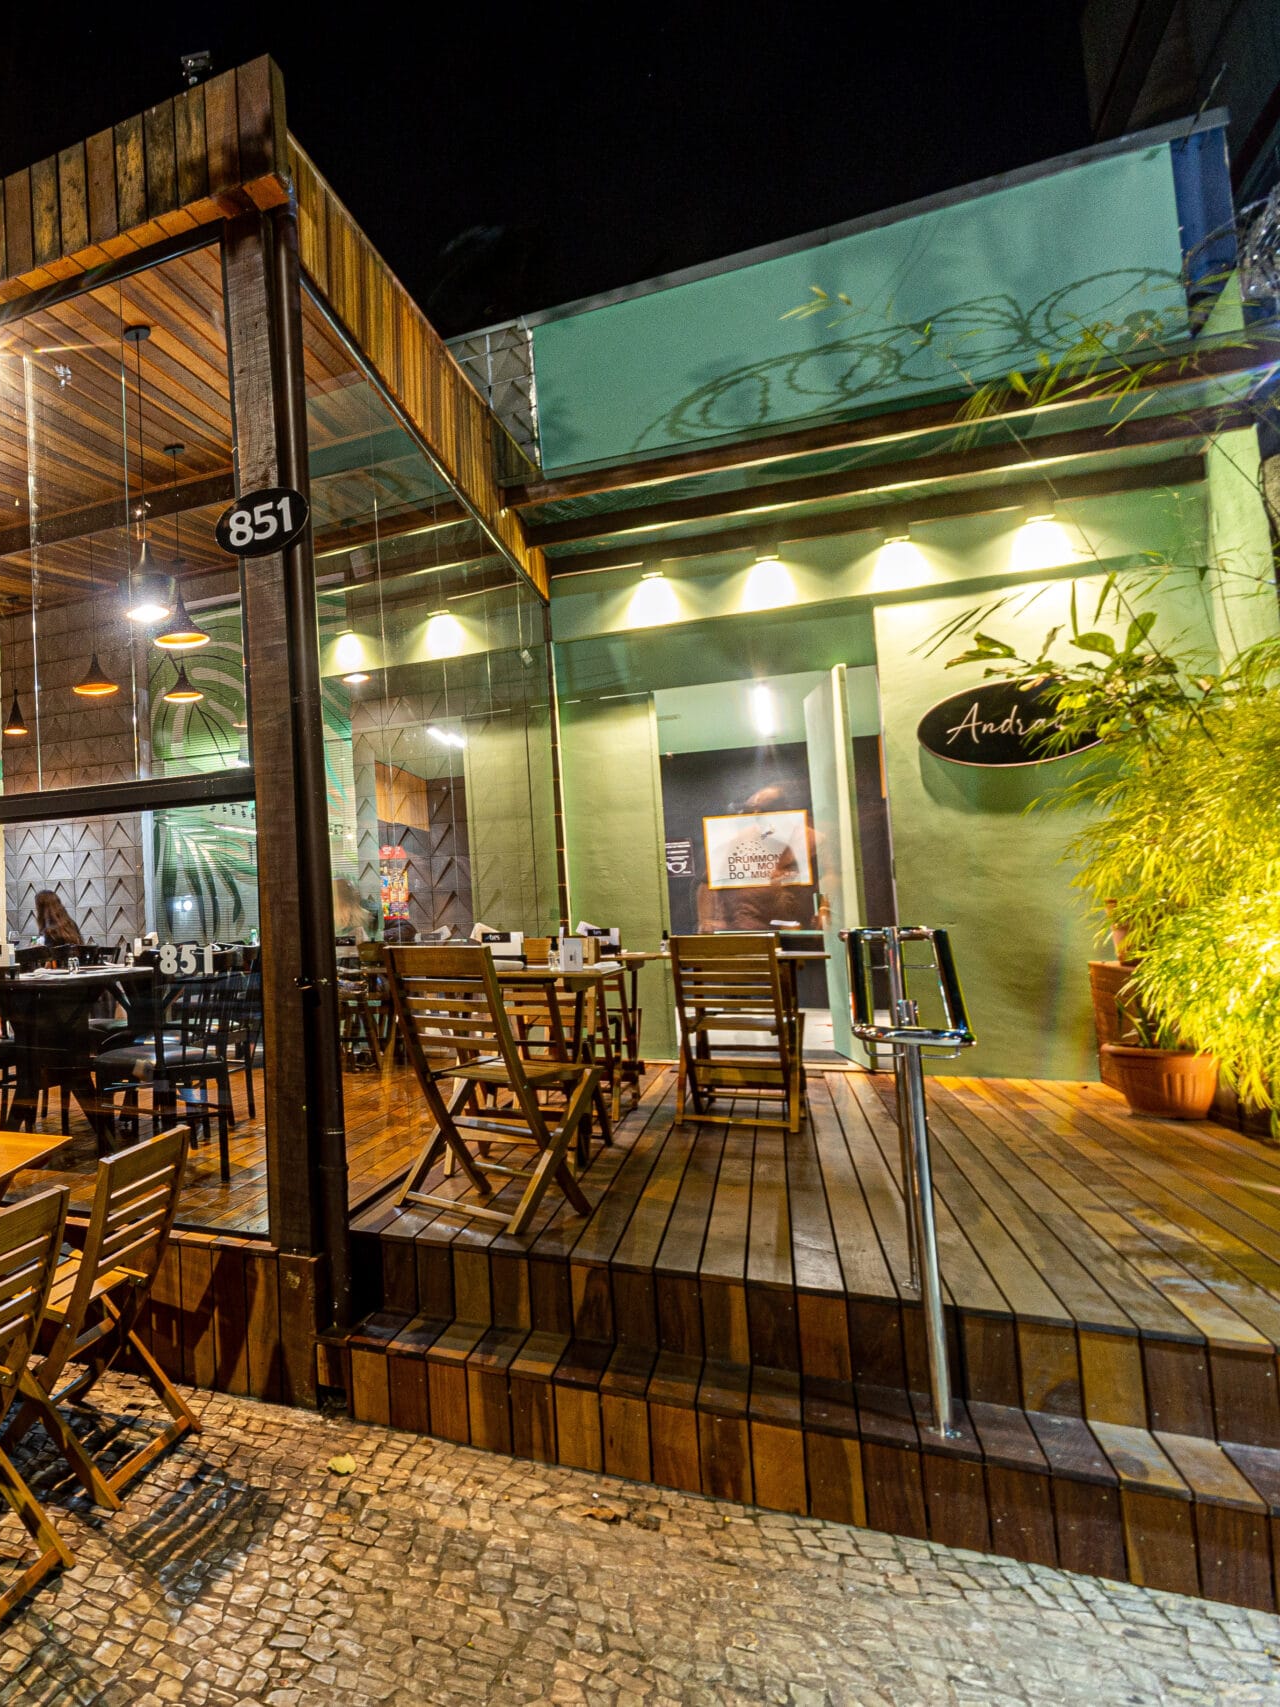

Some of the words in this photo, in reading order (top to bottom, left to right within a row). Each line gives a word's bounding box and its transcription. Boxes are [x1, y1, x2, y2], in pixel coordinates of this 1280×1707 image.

[229, 497, 292, 547] 851
[946, 702, 1067, 745] Andra
[729, 871, 745, 880] DO
[160, 943, 214, 975] 851
